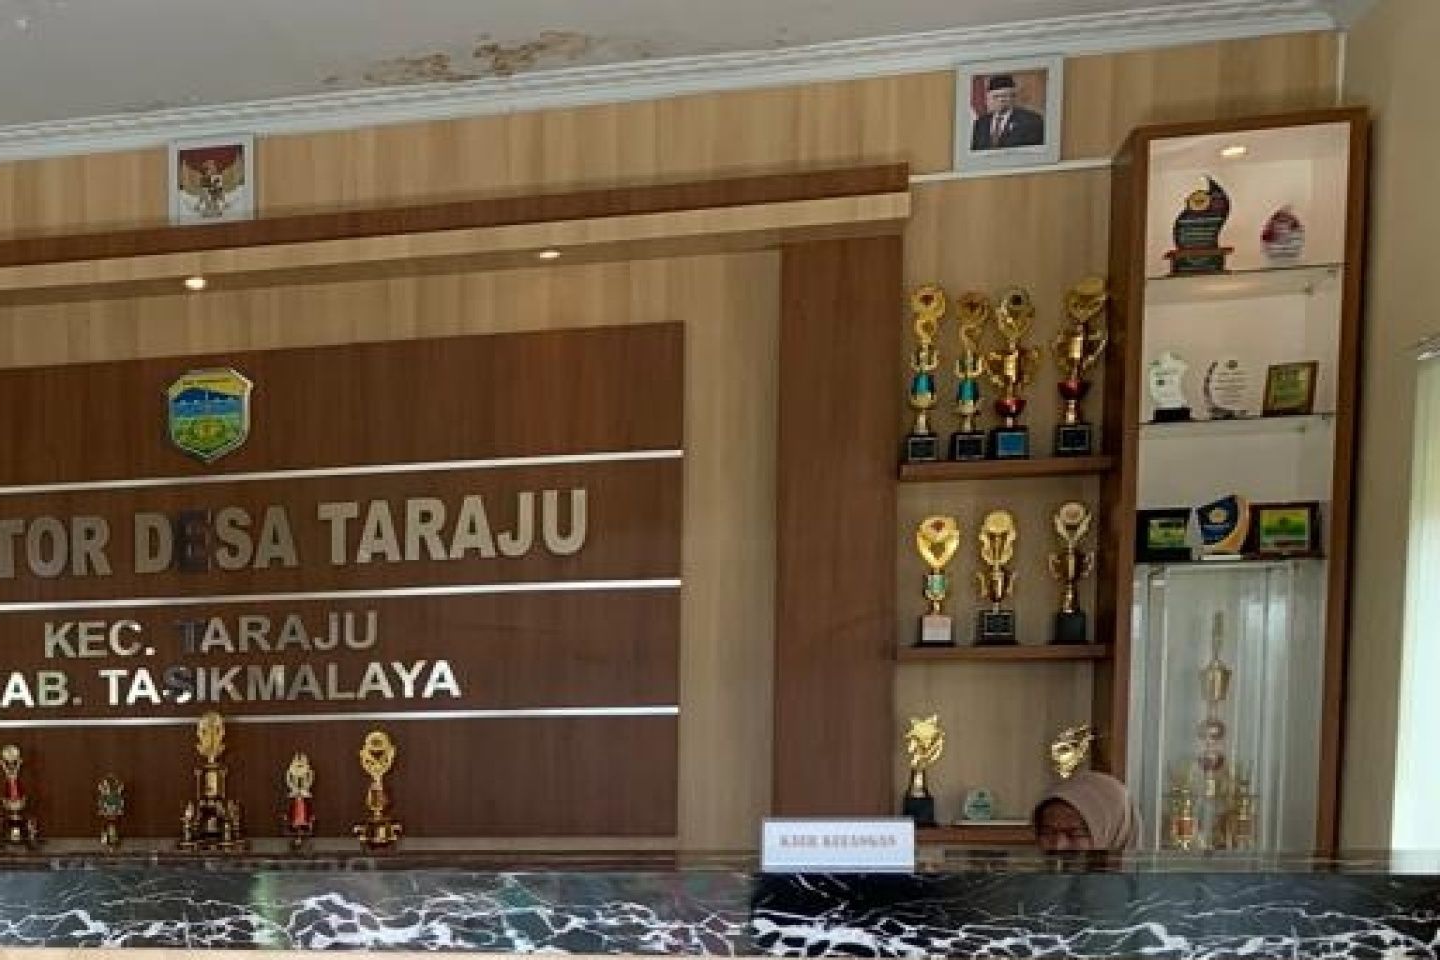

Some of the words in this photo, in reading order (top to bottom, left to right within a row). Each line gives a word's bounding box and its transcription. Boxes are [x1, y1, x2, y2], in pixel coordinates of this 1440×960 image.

[134, 504, 298, 573] DESA
[317, 489, 586, 565] TARAJU
[44, 619, 156, 658] KEC.
[176, 610, 378, 654] TARAJU
[98, 659, 461, 706] TASIKMALAYA
